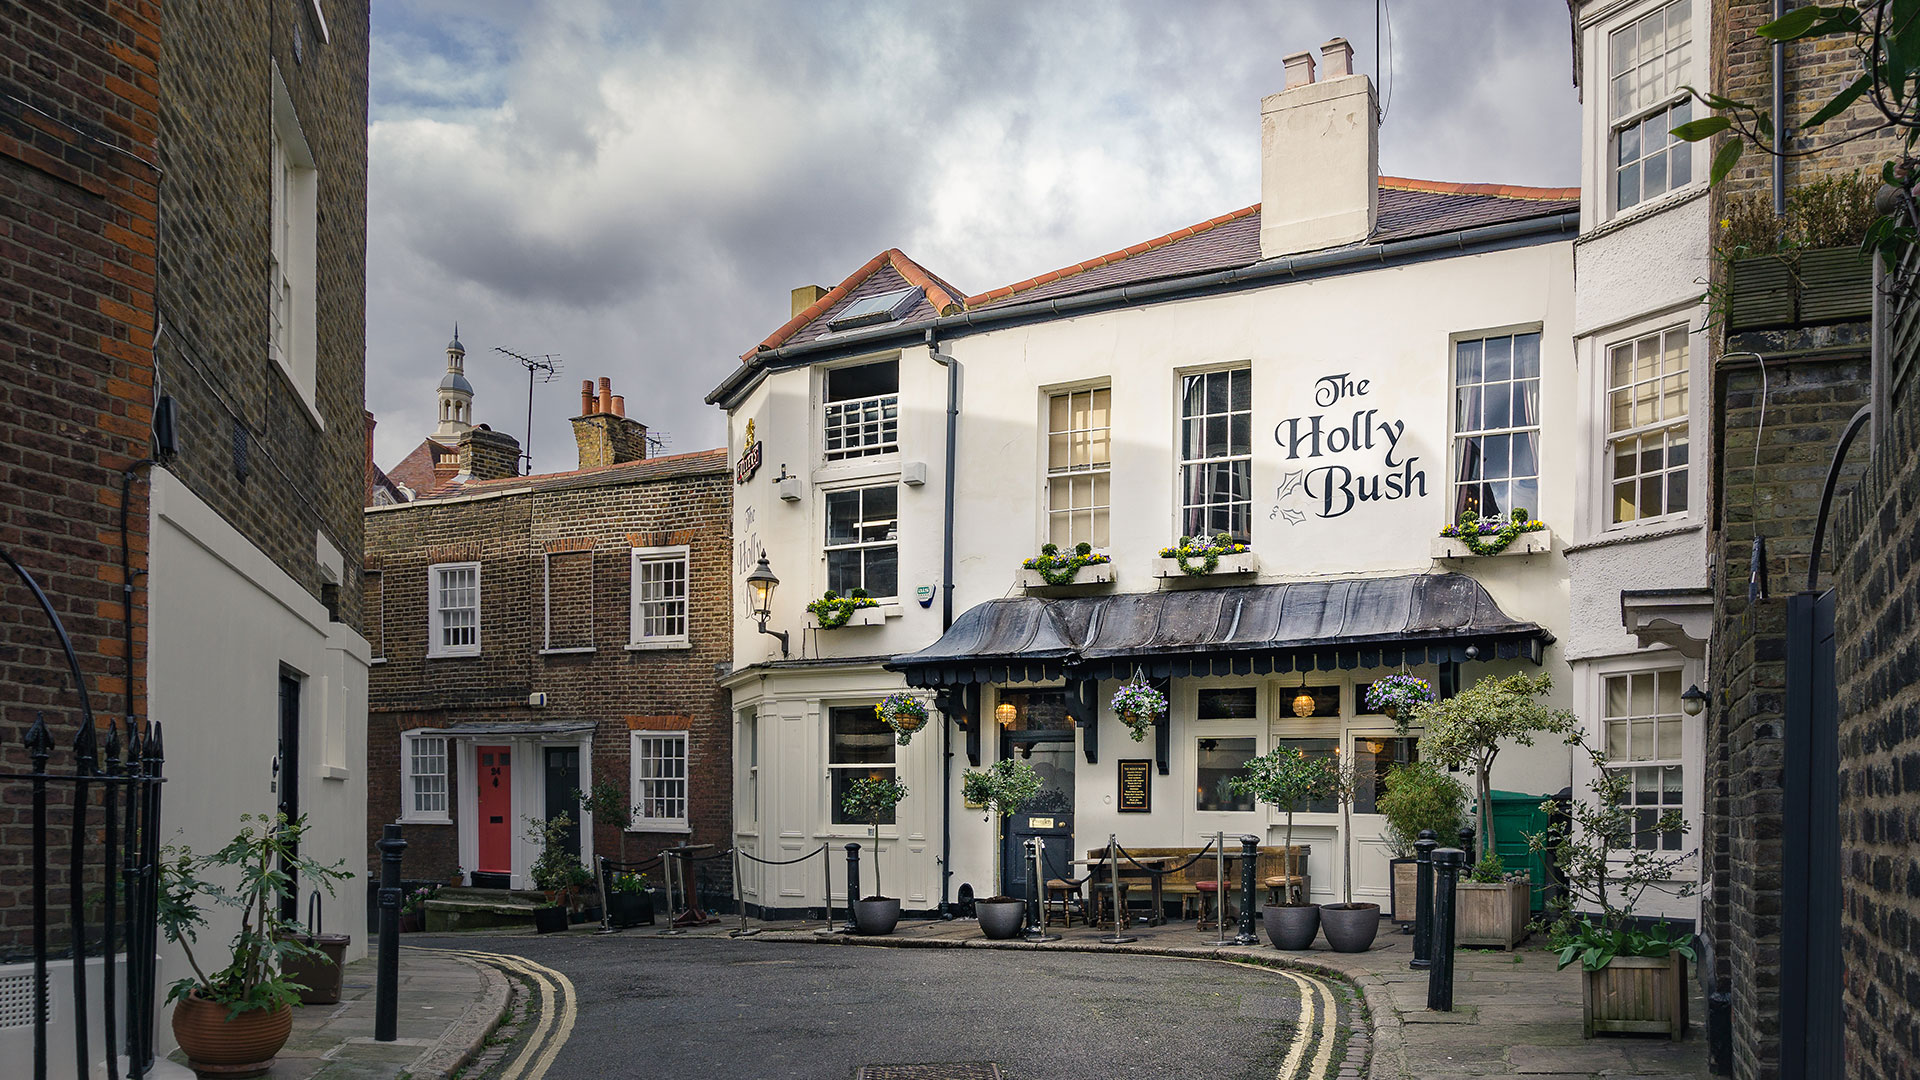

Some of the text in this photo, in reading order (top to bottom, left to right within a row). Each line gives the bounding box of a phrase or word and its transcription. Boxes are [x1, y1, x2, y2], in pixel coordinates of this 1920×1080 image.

[1315, 372, 1370, 407] The
[1274, 409, 1405, 468] Holly
[1304, 456, 1429, 518] Bush
